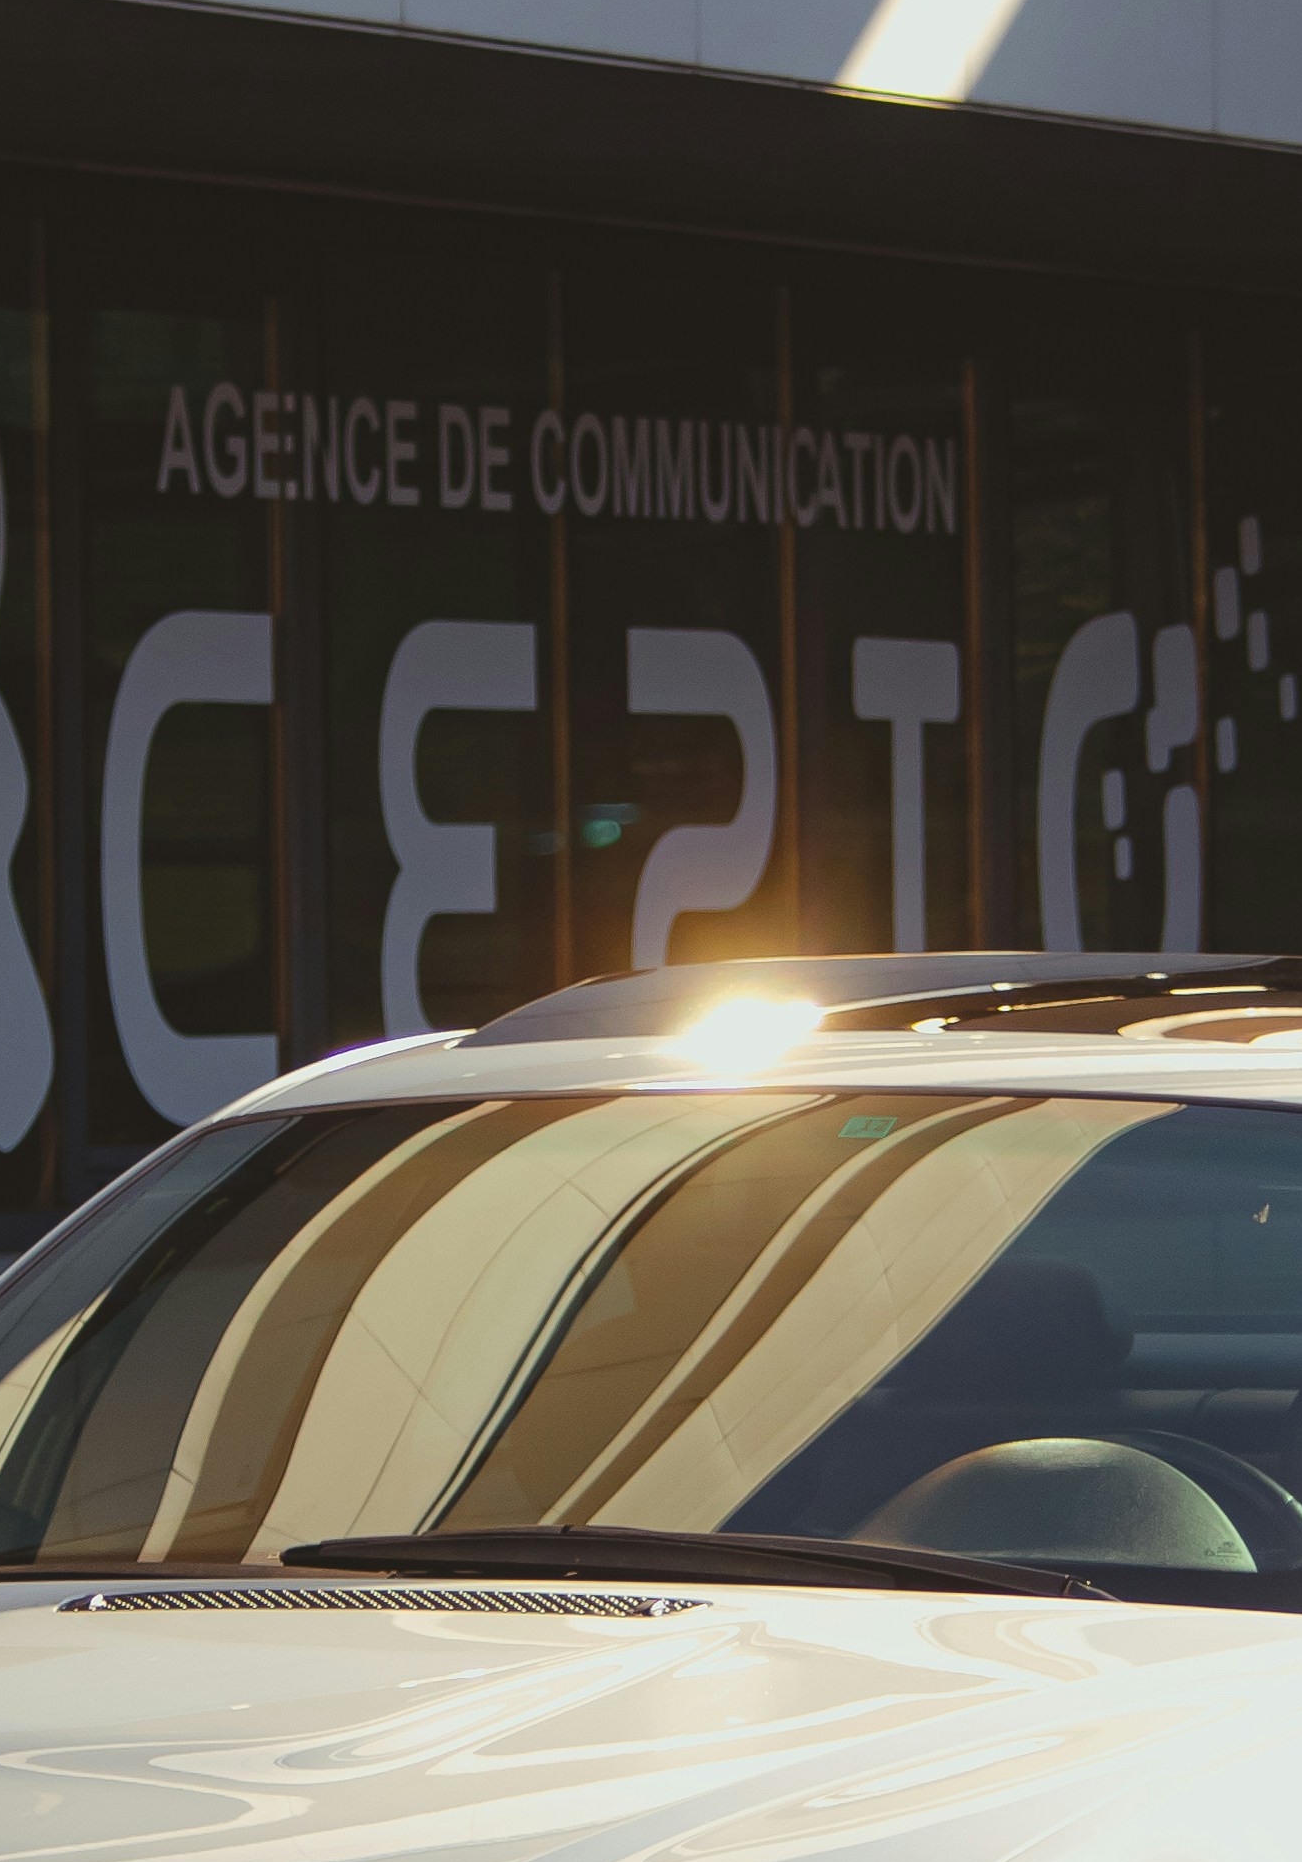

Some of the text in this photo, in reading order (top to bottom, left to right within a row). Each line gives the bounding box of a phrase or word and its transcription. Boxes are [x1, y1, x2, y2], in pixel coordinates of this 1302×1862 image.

[156, 382, 960, 535] AGENCE DE COMMUNICATION
